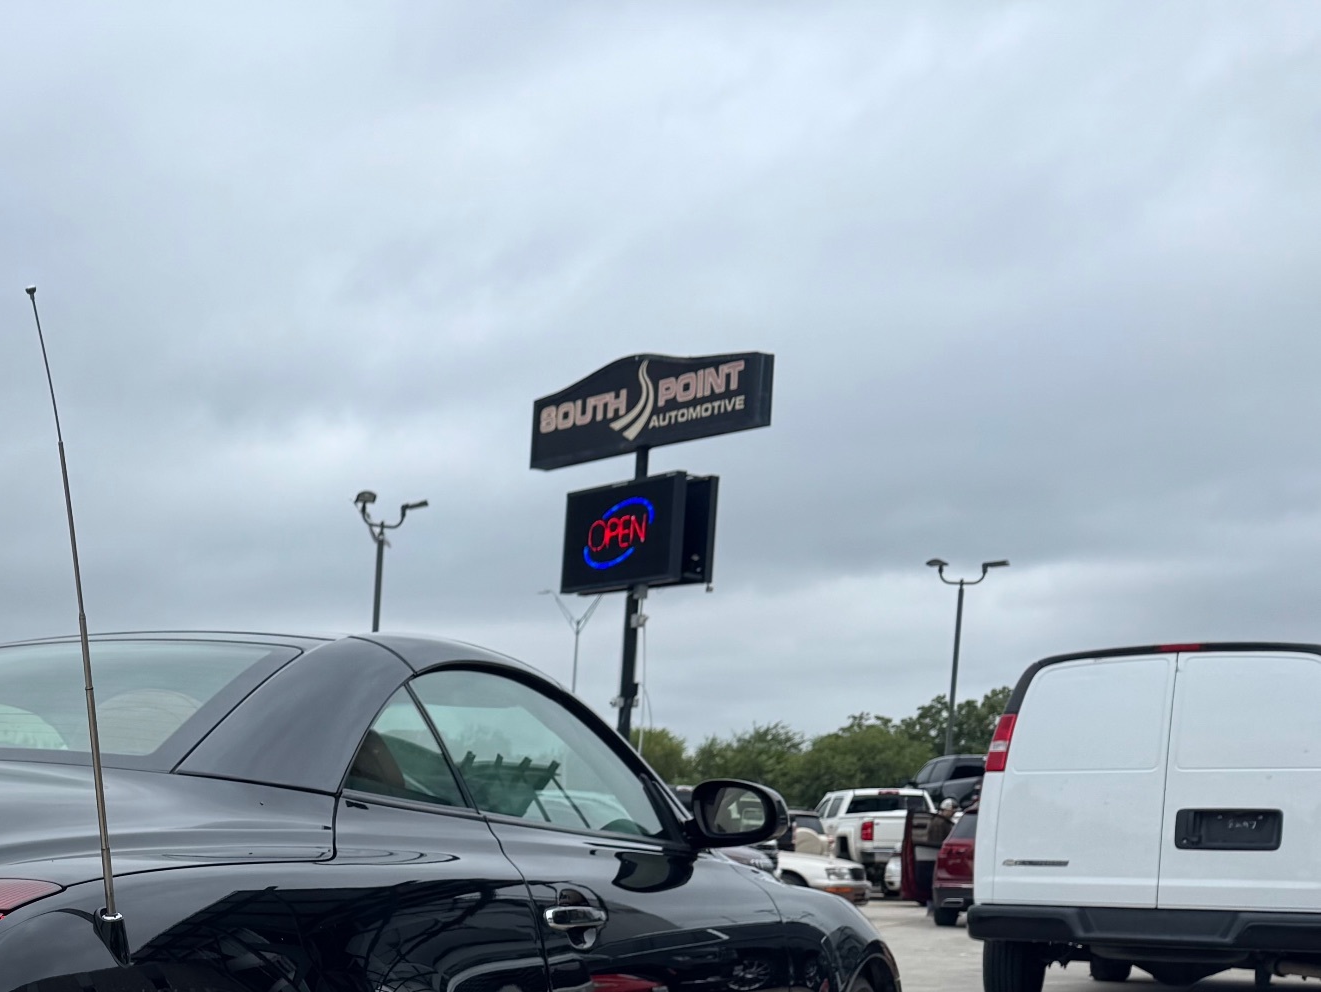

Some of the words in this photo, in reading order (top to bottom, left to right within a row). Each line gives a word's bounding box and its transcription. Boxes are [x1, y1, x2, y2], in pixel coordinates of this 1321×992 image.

[539, 388, 627, 434] SOUTH
[657, 360, 745, 408] POINT
[649, 395, 745, 430] AUTOMOTIVE
[588, 514, 648, 552] OPEN
